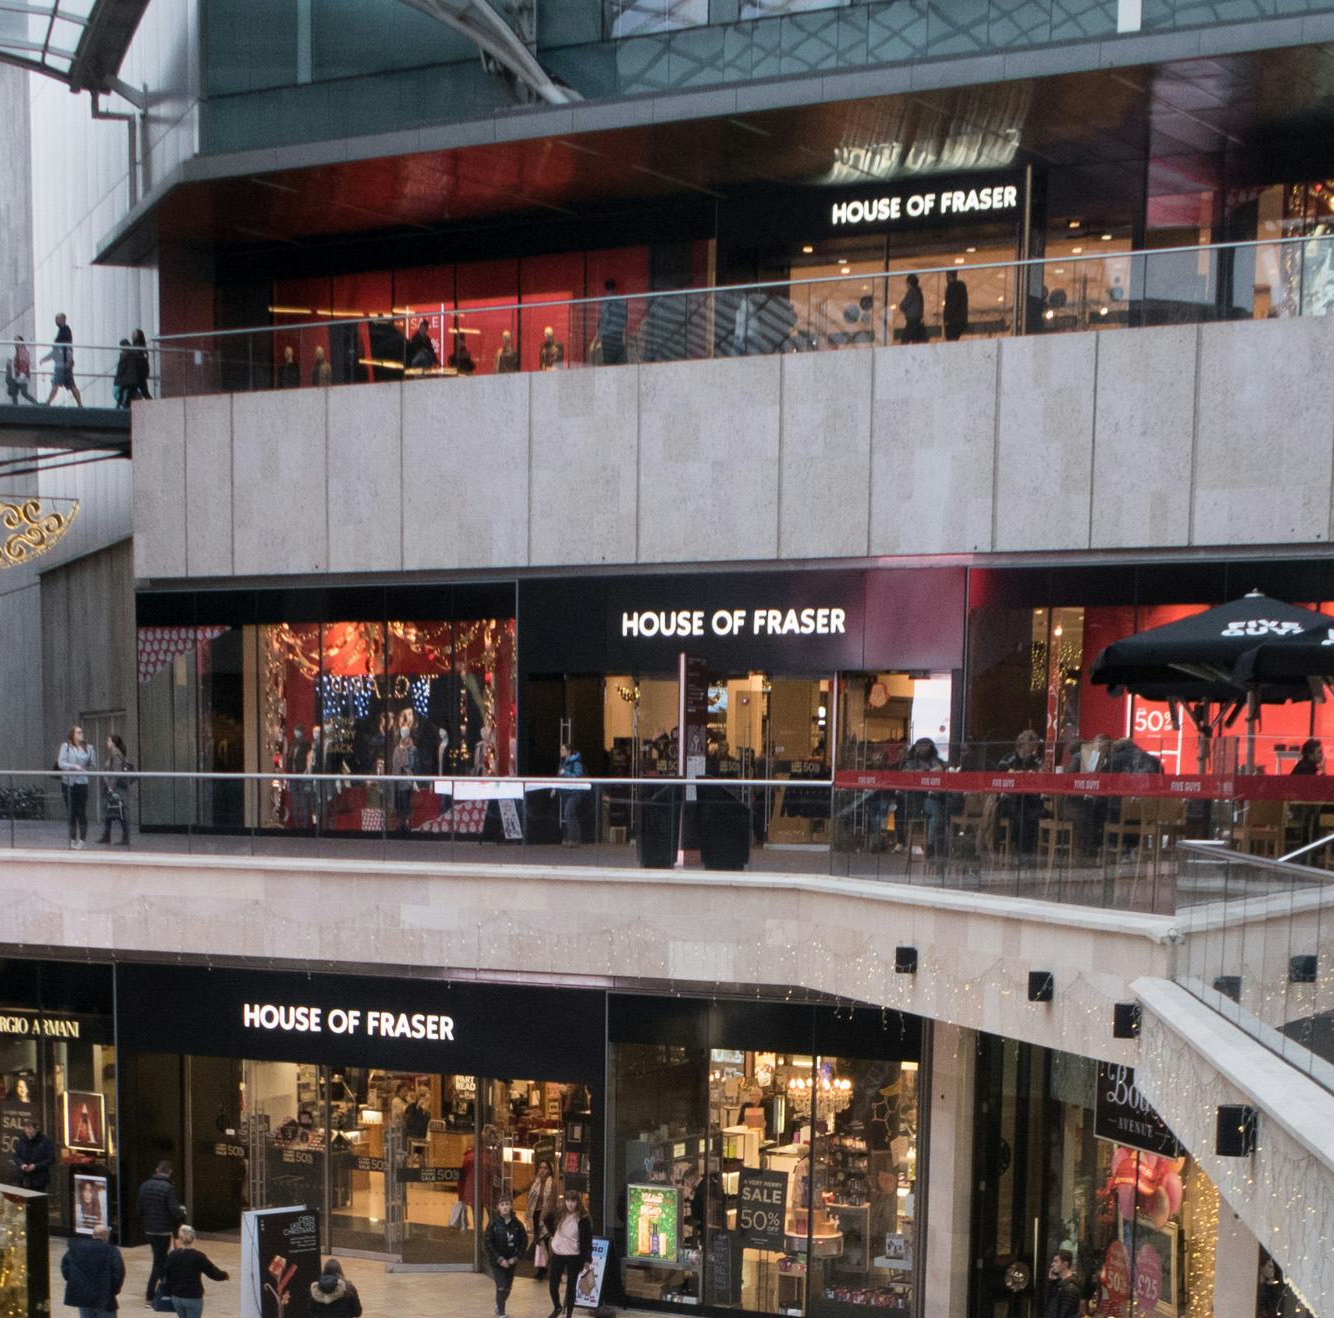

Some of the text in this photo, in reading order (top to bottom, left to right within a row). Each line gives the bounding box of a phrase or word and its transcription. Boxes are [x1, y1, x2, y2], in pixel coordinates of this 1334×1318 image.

[832, 185, 1017, 225] HOUSE OF FRASER
[622, 608, 846, 637] HOUSE OF FRASER
[32, 1018, 80, 1038] ARMANI
[244, 1003, 455, 1041] HOUSE OF FRASER
[3, 1117, 25, 1130] SAL
[1118, 1119, 1154, 1138] AVENUE
[742, 1186, 782, 1204] SALE
[740, 1209, 780, 1231] 50%
